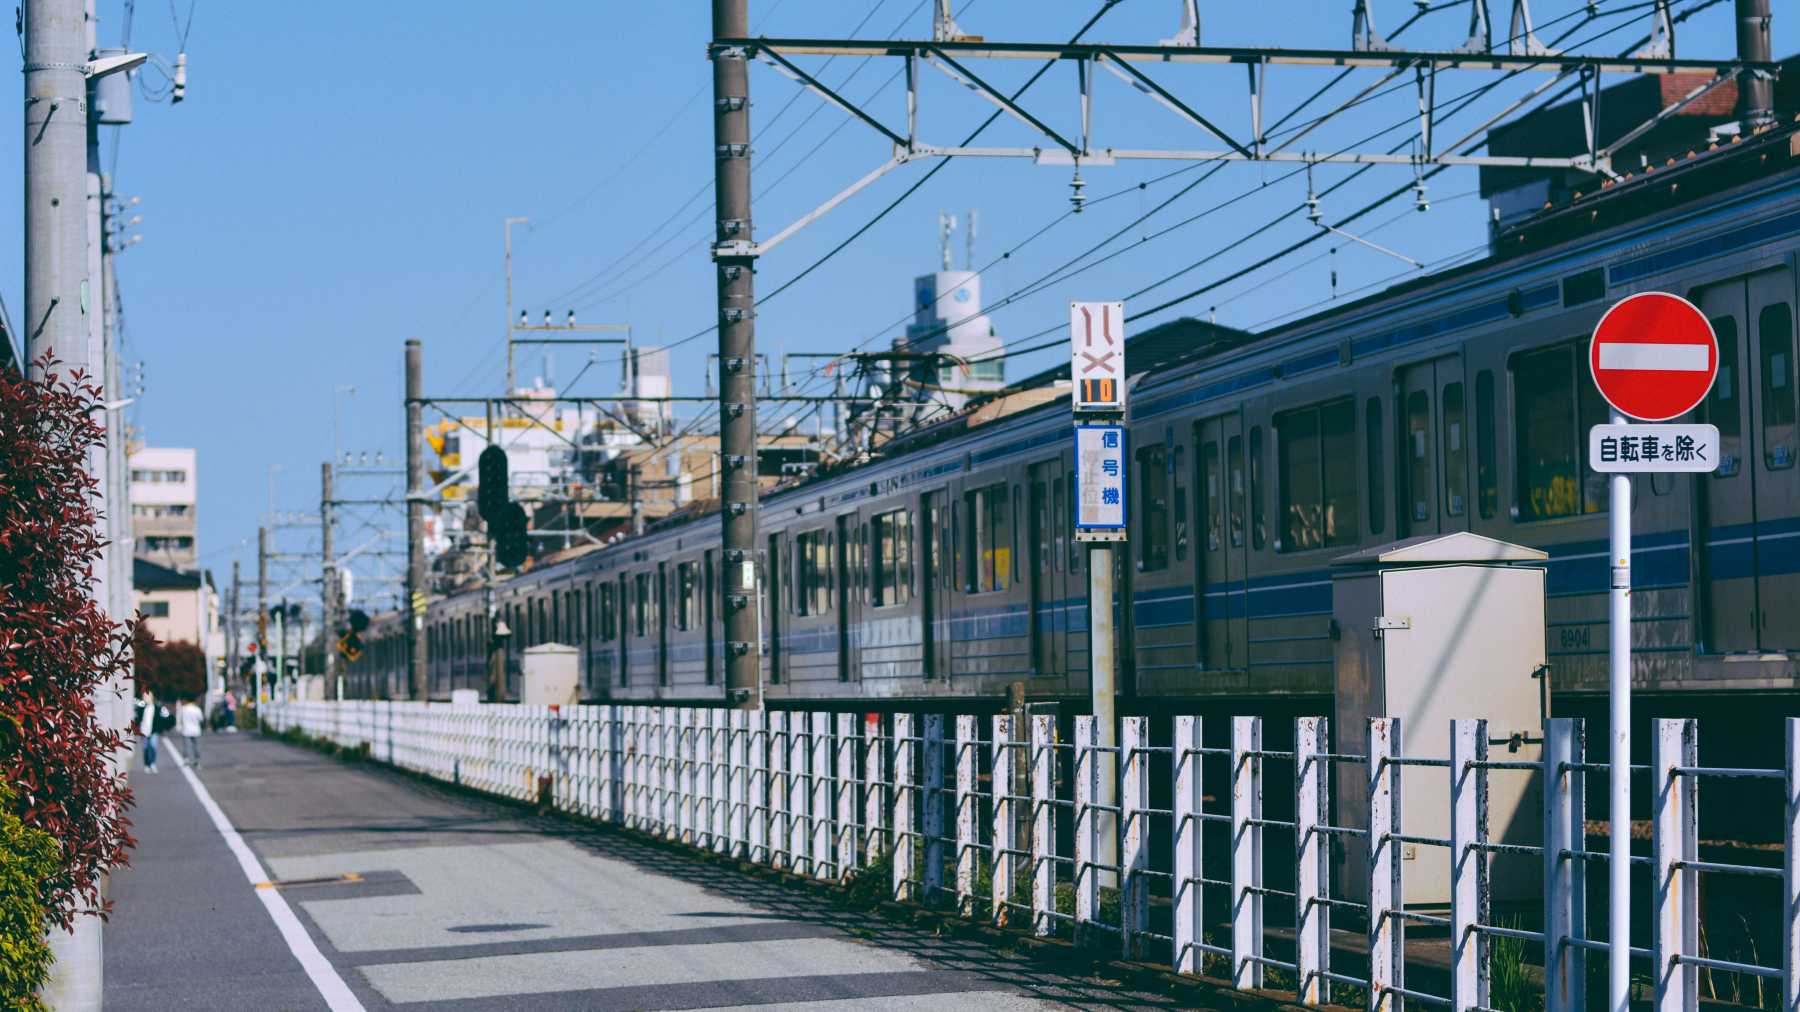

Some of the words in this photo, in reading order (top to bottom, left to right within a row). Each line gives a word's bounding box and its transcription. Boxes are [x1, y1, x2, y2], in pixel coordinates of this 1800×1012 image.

[1084, 378, 1112, 402] 10
[1600, 435, 1707, 463] 自転車を除く
[1102, 431, 1120, 505] 信号機
